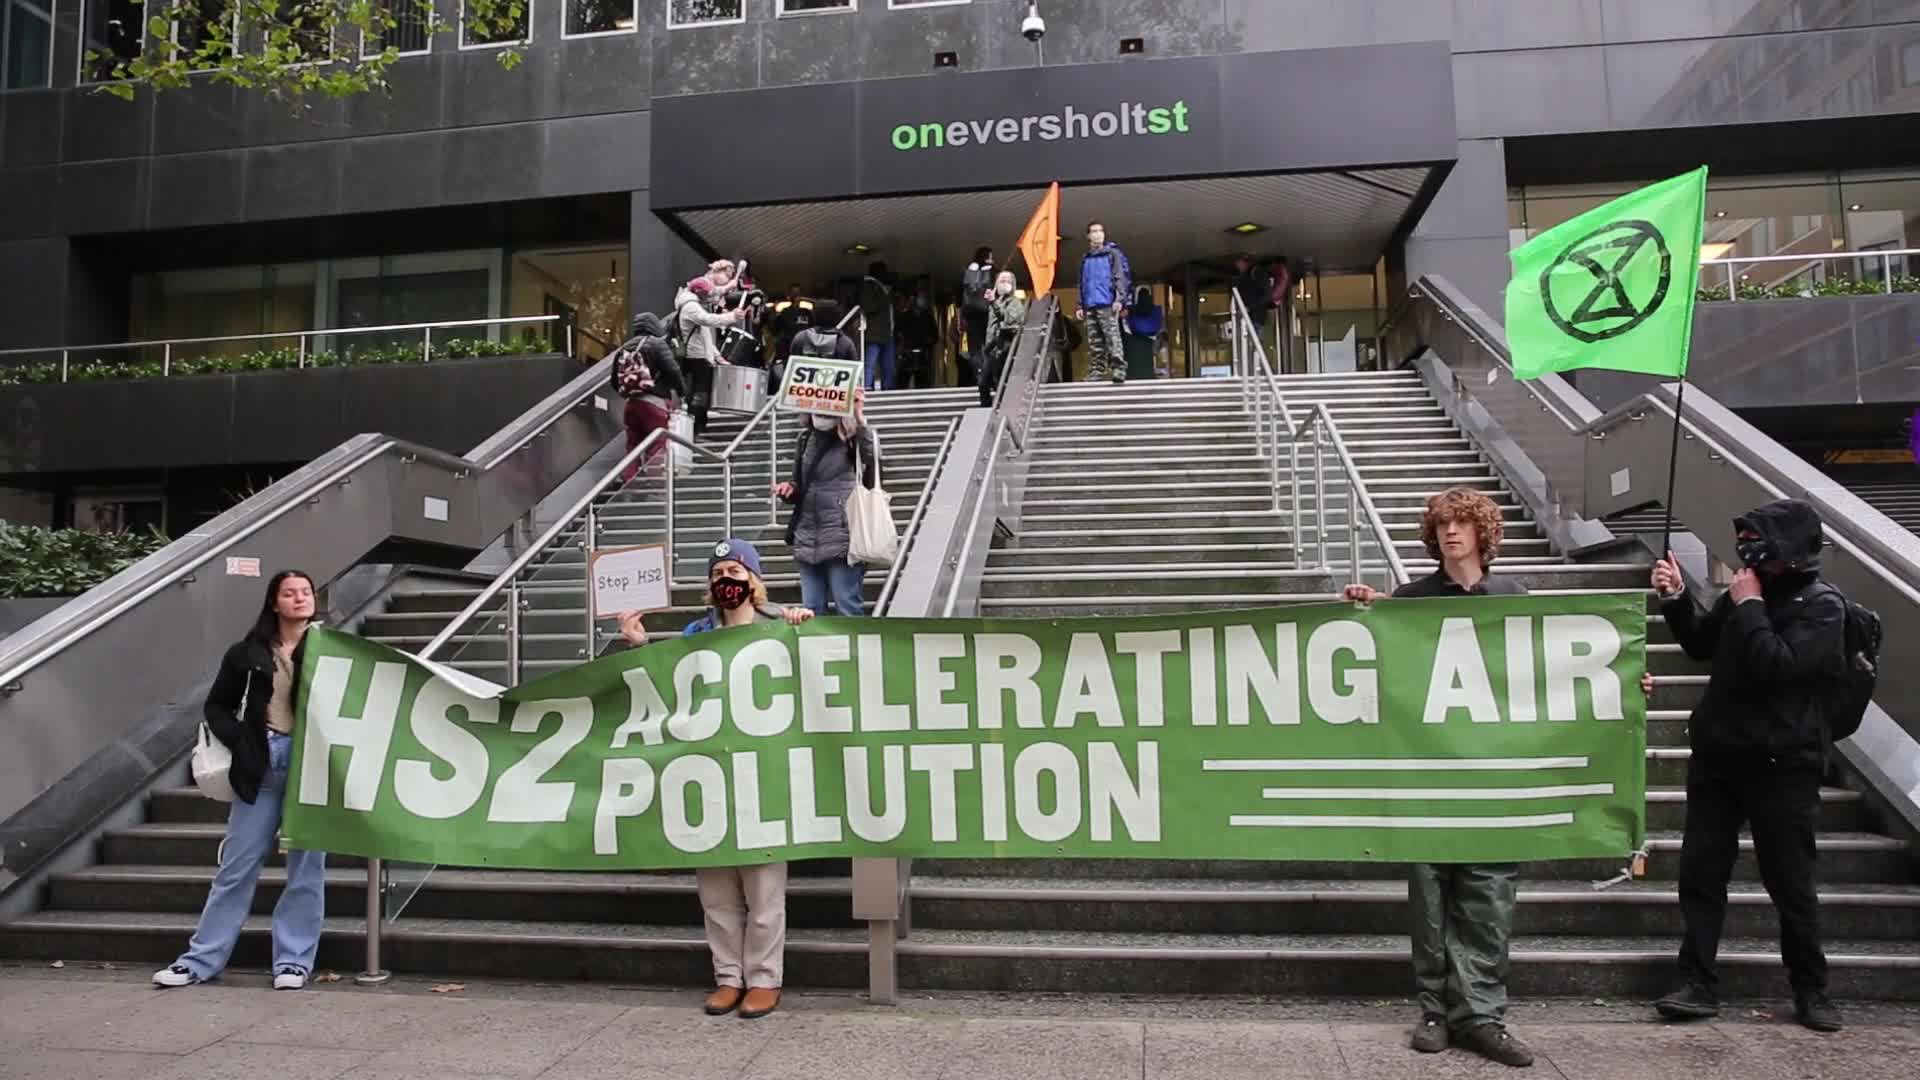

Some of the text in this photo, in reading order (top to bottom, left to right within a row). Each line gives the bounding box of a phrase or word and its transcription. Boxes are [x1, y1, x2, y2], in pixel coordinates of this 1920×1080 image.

[891, 100, 1189, 150] oneversholtst
[788, 386, 847, 401] ECOCIDE
[793, 367, 850, 387] STOP
[599, 568, 664, 591] Stop HS2
[610, 614, 1624, 749] ACCELERATING AIR
[298, 655, 595, 822] HS2
[594, 740, 1161, 855] POLLUTION
